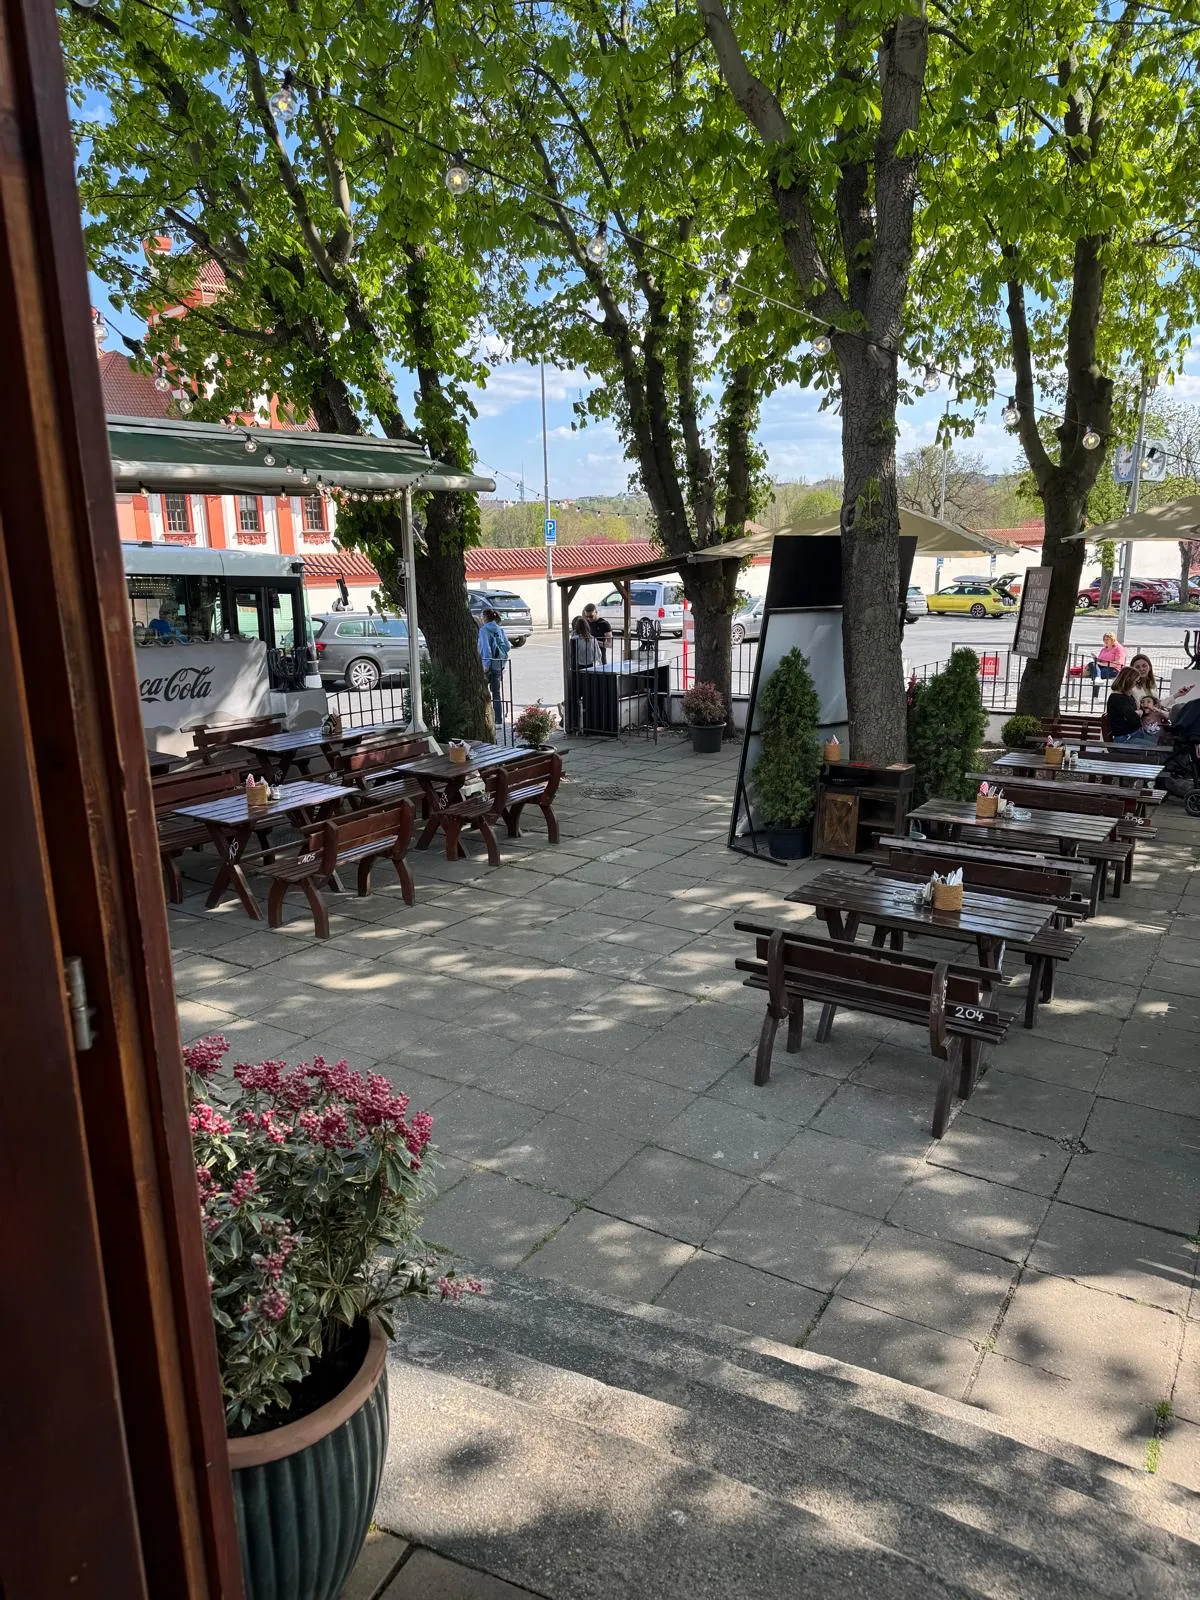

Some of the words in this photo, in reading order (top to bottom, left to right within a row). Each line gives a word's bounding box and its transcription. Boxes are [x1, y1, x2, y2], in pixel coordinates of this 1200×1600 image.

[547, 522, 554, 535] P
[139, 666, 215, 703] ca-Cola
[302, 852, 316, 864] 105
[955, 1006, 985, 1022] 204
